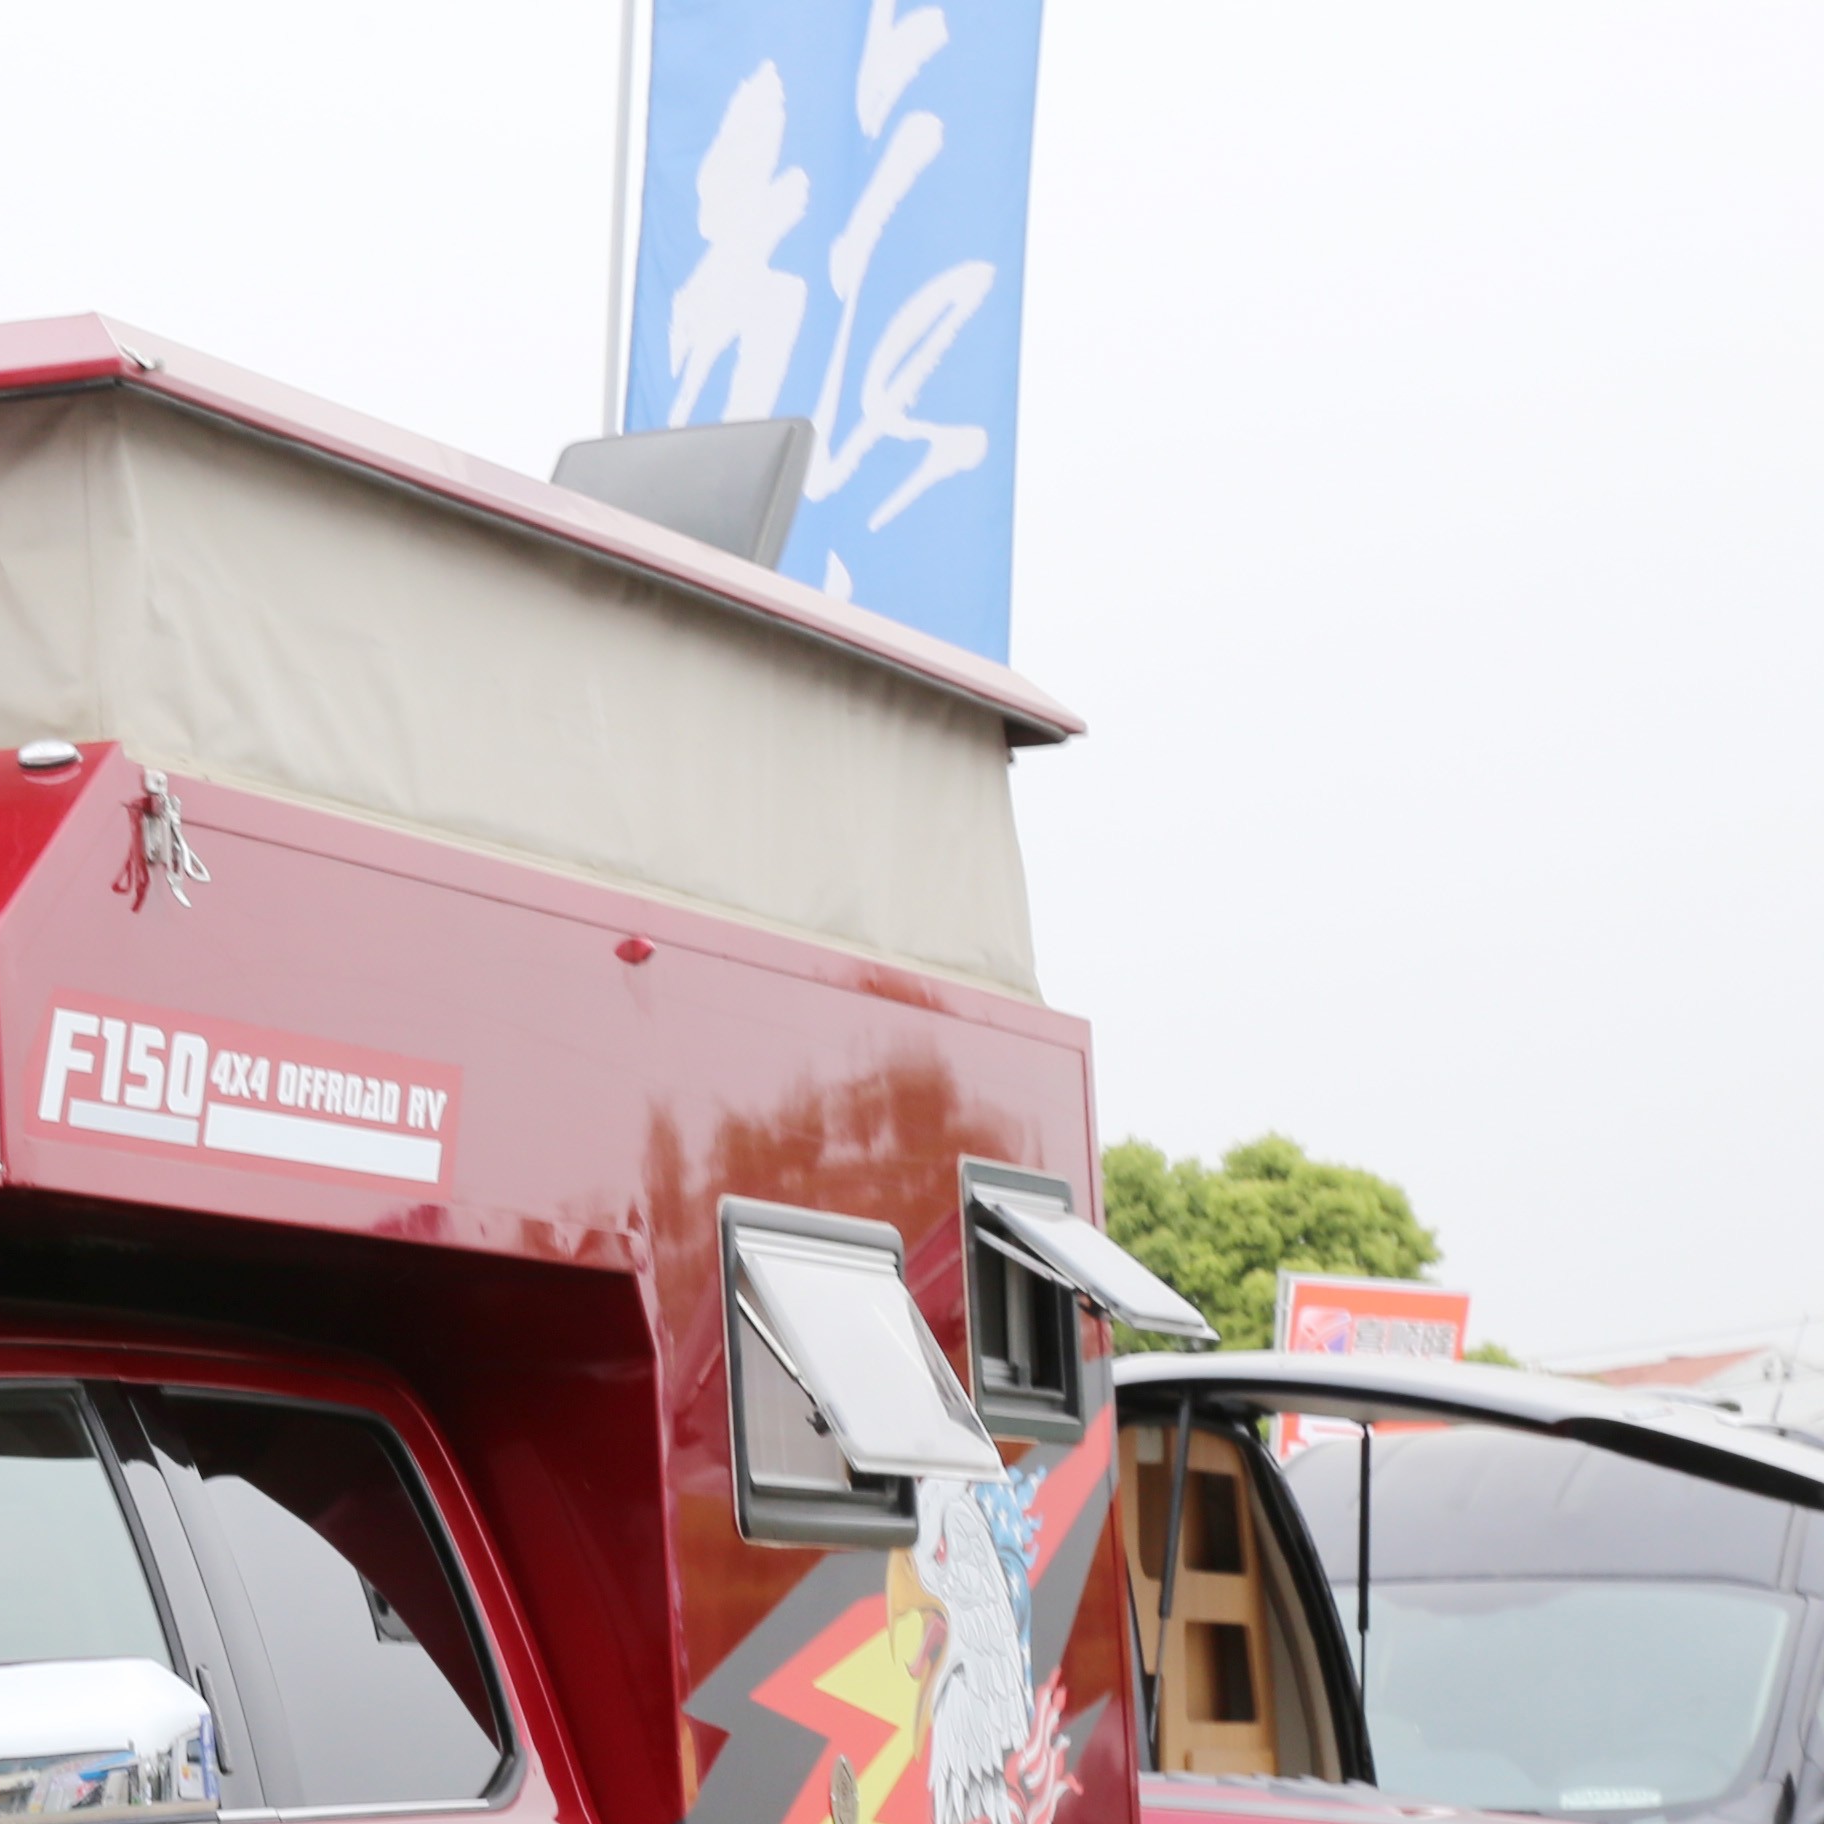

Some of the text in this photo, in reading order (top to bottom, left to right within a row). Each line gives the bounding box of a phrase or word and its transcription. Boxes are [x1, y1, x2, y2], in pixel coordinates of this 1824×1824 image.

[37, 1006, 449, 1133] F150 4X4 OFFROAD RV
